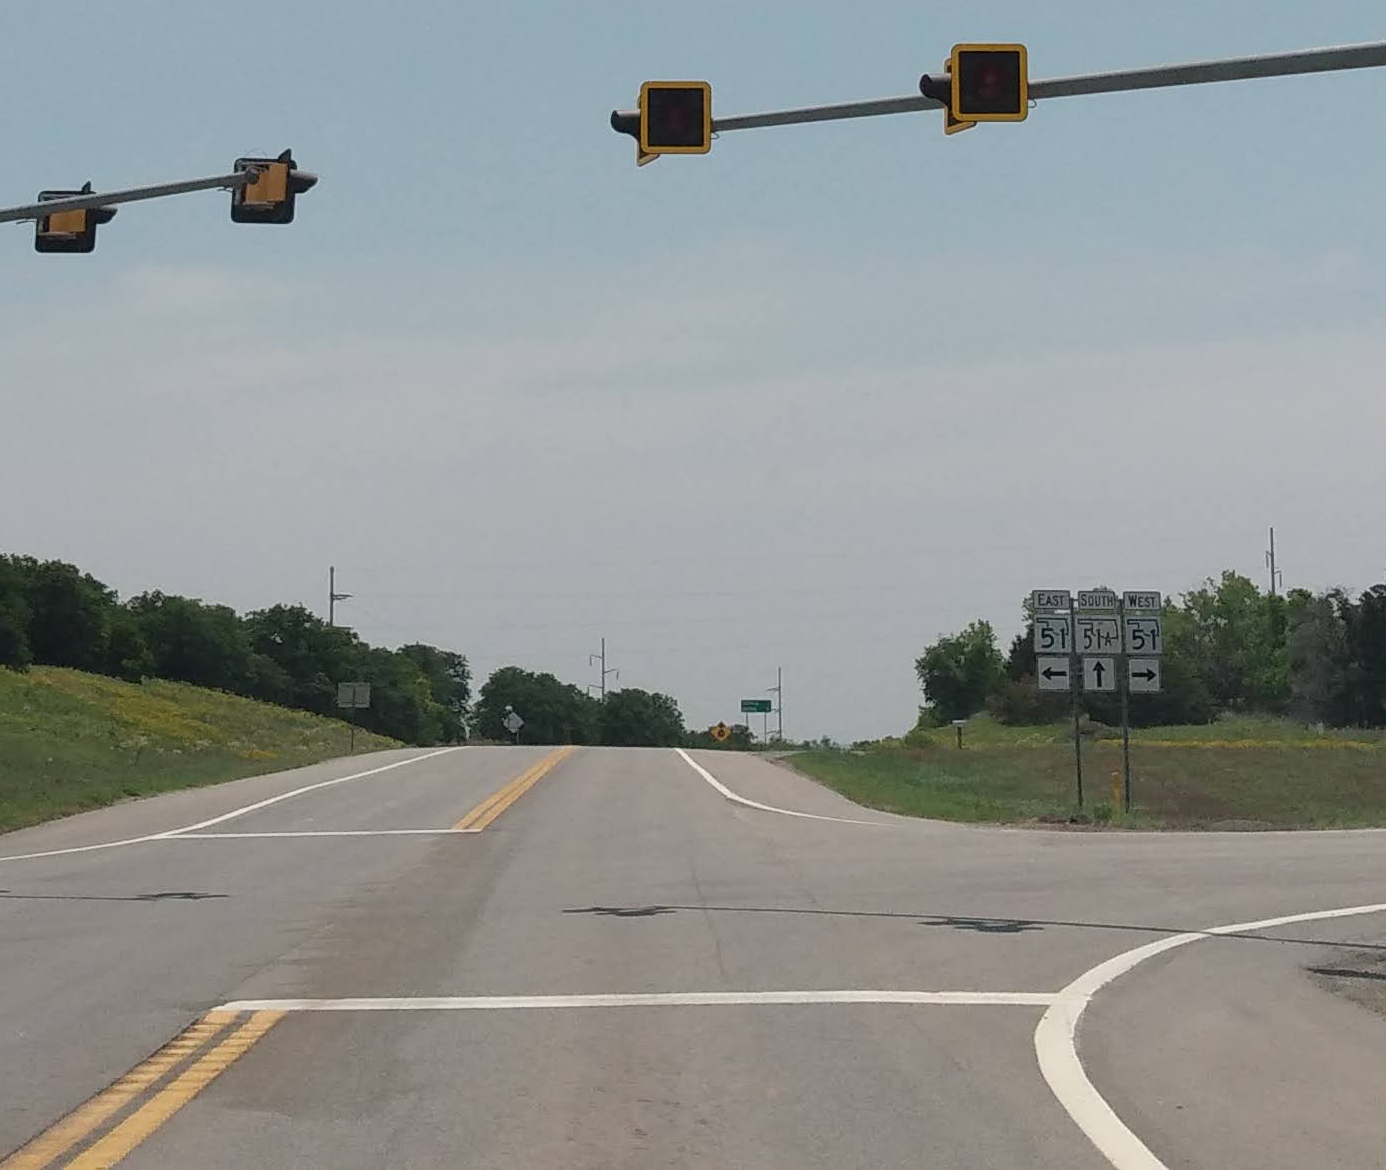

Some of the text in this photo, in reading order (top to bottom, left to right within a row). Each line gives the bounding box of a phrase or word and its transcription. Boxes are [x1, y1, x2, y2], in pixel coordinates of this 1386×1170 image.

[1037, 593, 1064, 606] EAST
[1081, 594, 1113, 607] SOUTH
[1128, 595, 1155, 607] WEST
[1041, 628, 1065, 649] 51
[1084, 629, 1112, 649] 51A
[1132, 629, 1156, 649] 51
